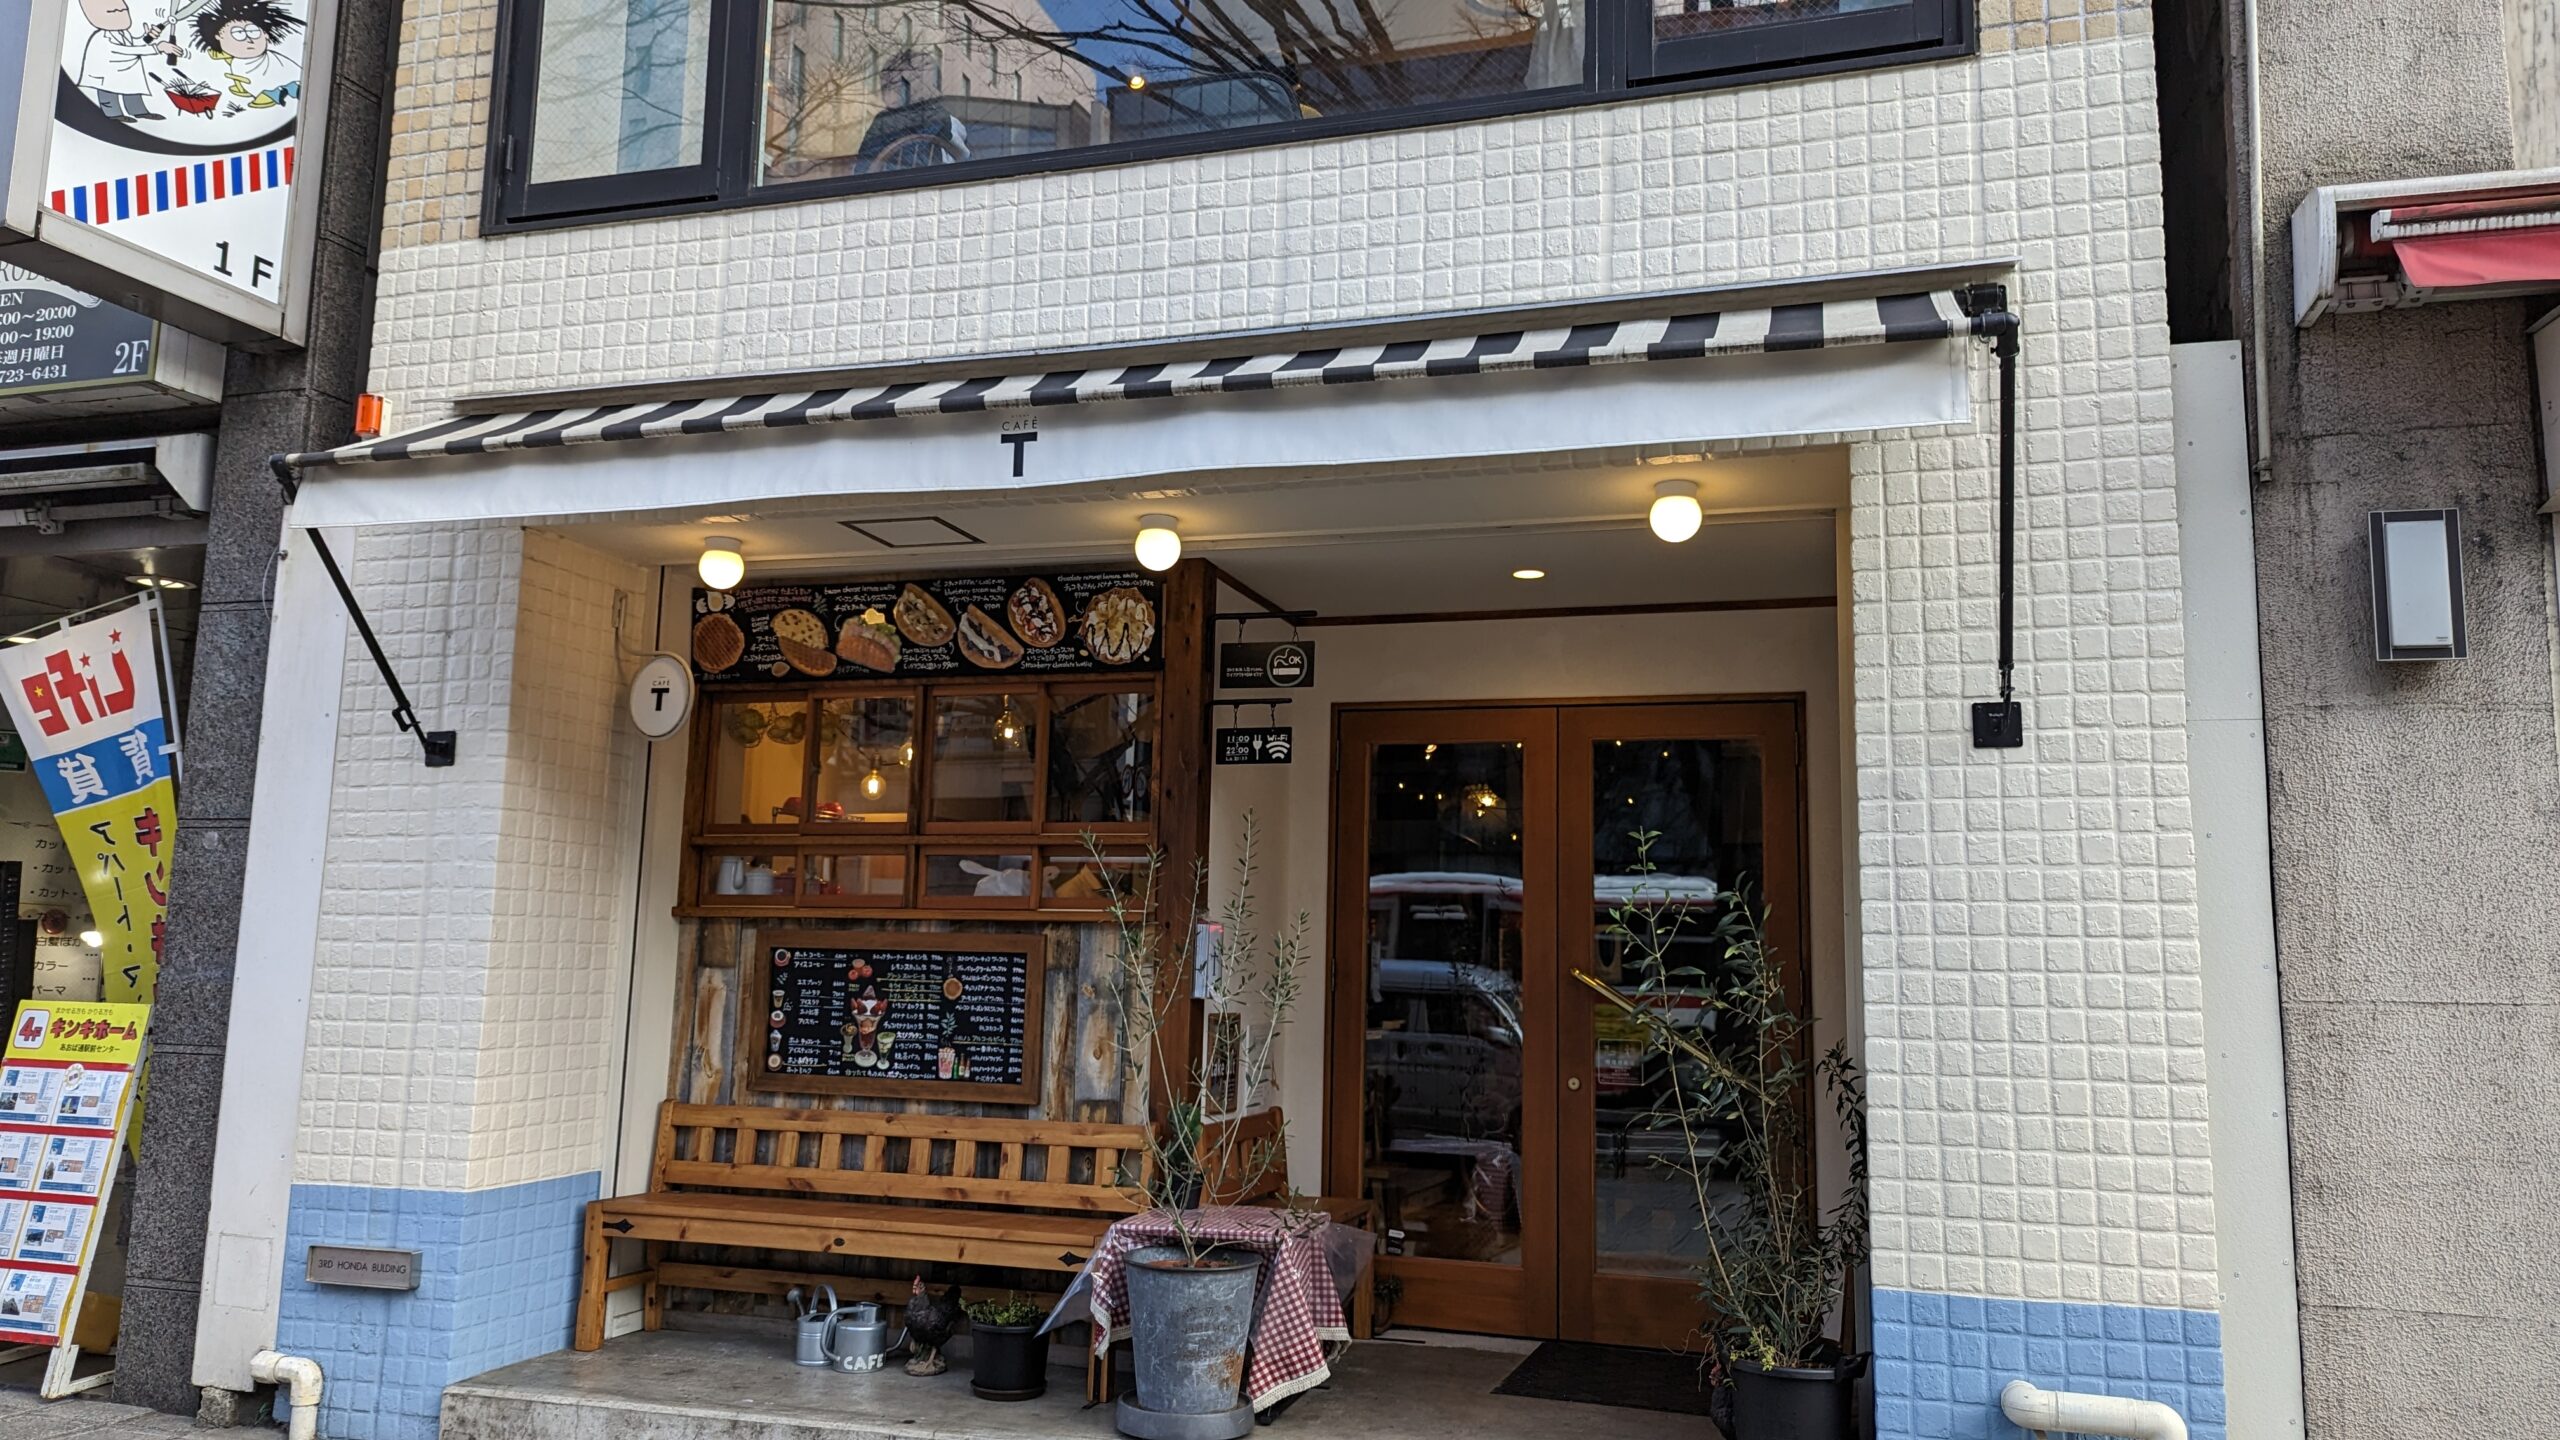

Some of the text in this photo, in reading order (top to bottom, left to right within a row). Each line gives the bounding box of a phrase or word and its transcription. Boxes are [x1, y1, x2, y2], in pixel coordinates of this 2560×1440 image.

[112, 339, 150, 374] 2F
[1001, 432, 1038, 477] T
[1289, 655, 1302, 665] OK
[650, 687, 670, 712] T
[1267, 734, 1288, 742] Wi-Fi
[19, 1016, 44, 1042] 4F
[50, 1017, 138, 1041] キンキホーム
[318, 1259, 334, 1269] 3RD
[338, 1260, 368, 1272] HONDA
[844, 1353, 884, 1371] CAFE
